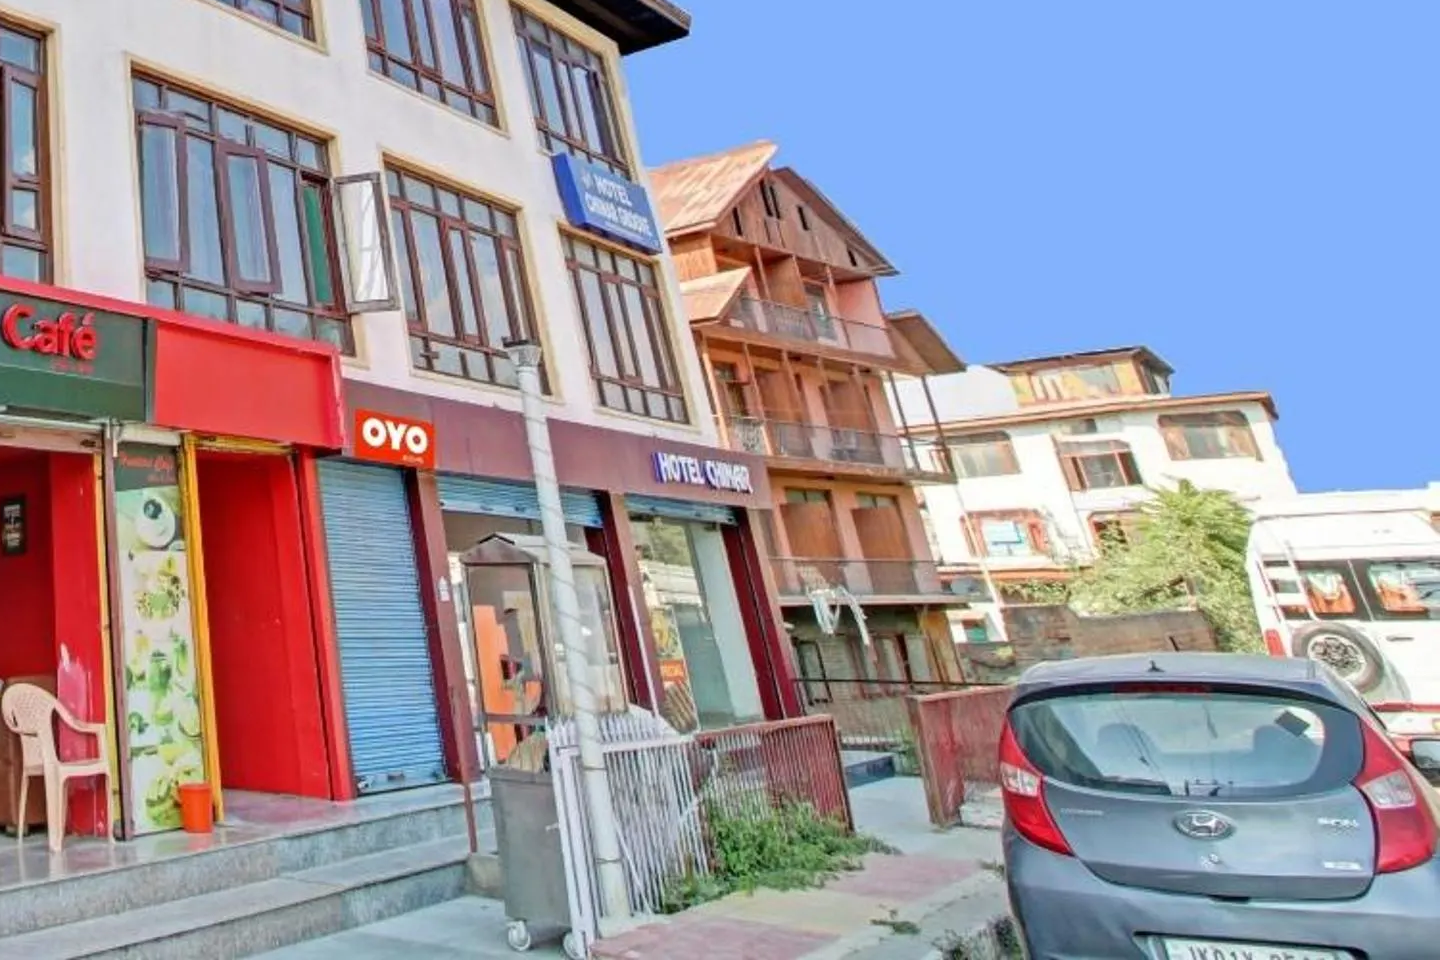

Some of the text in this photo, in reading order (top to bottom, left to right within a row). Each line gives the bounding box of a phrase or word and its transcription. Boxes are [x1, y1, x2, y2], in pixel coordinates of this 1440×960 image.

[592, 173, 633, 207] HOTEL
[0, 303, 98, 361] Café
[362, 417, 429, 455] OYO
[653, 452, 706, 485] HOTEL
